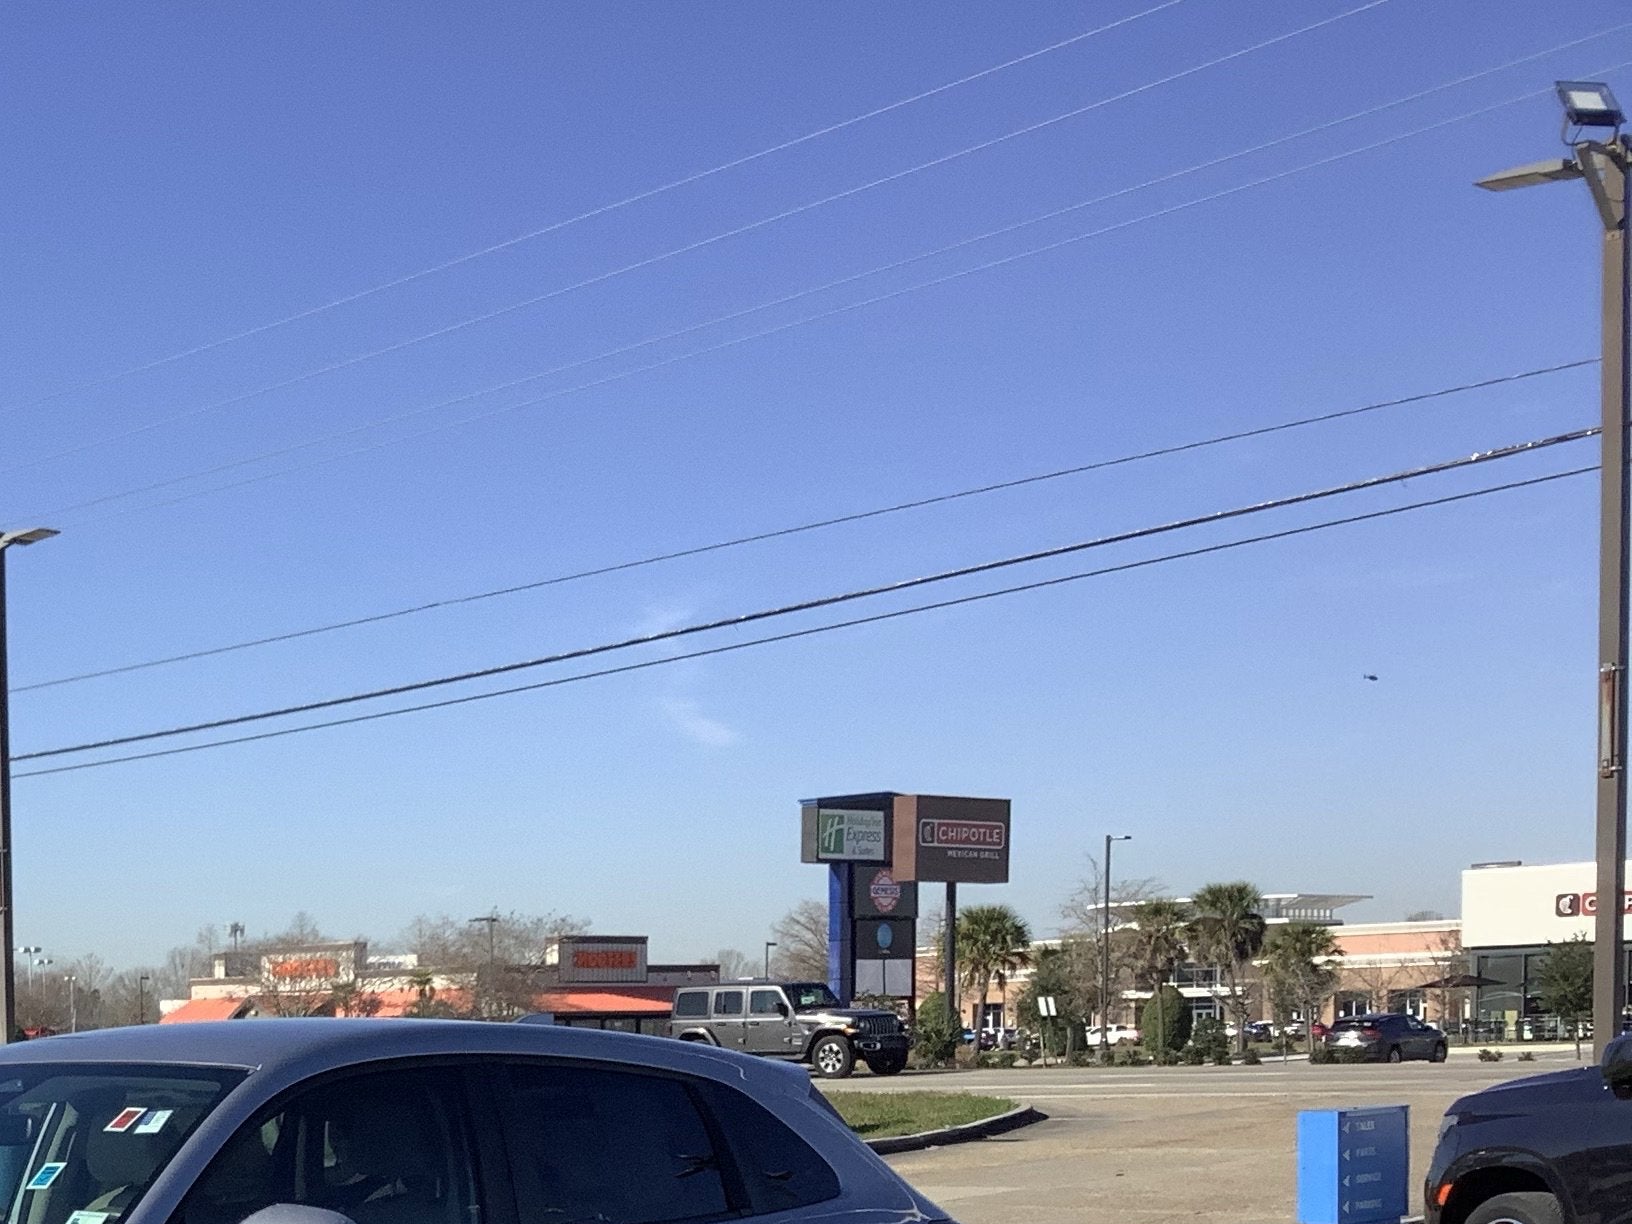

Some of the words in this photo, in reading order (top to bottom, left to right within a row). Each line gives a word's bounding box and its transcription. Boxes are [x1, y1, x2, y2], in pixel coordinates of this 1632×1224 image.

[846, 826, 882, 845] Express
[938, 826, 1001, 843] CHIPOTLE
[947, 849, 978, 858] MEXICAN
[979, 851, 1000, 860] GRILL
